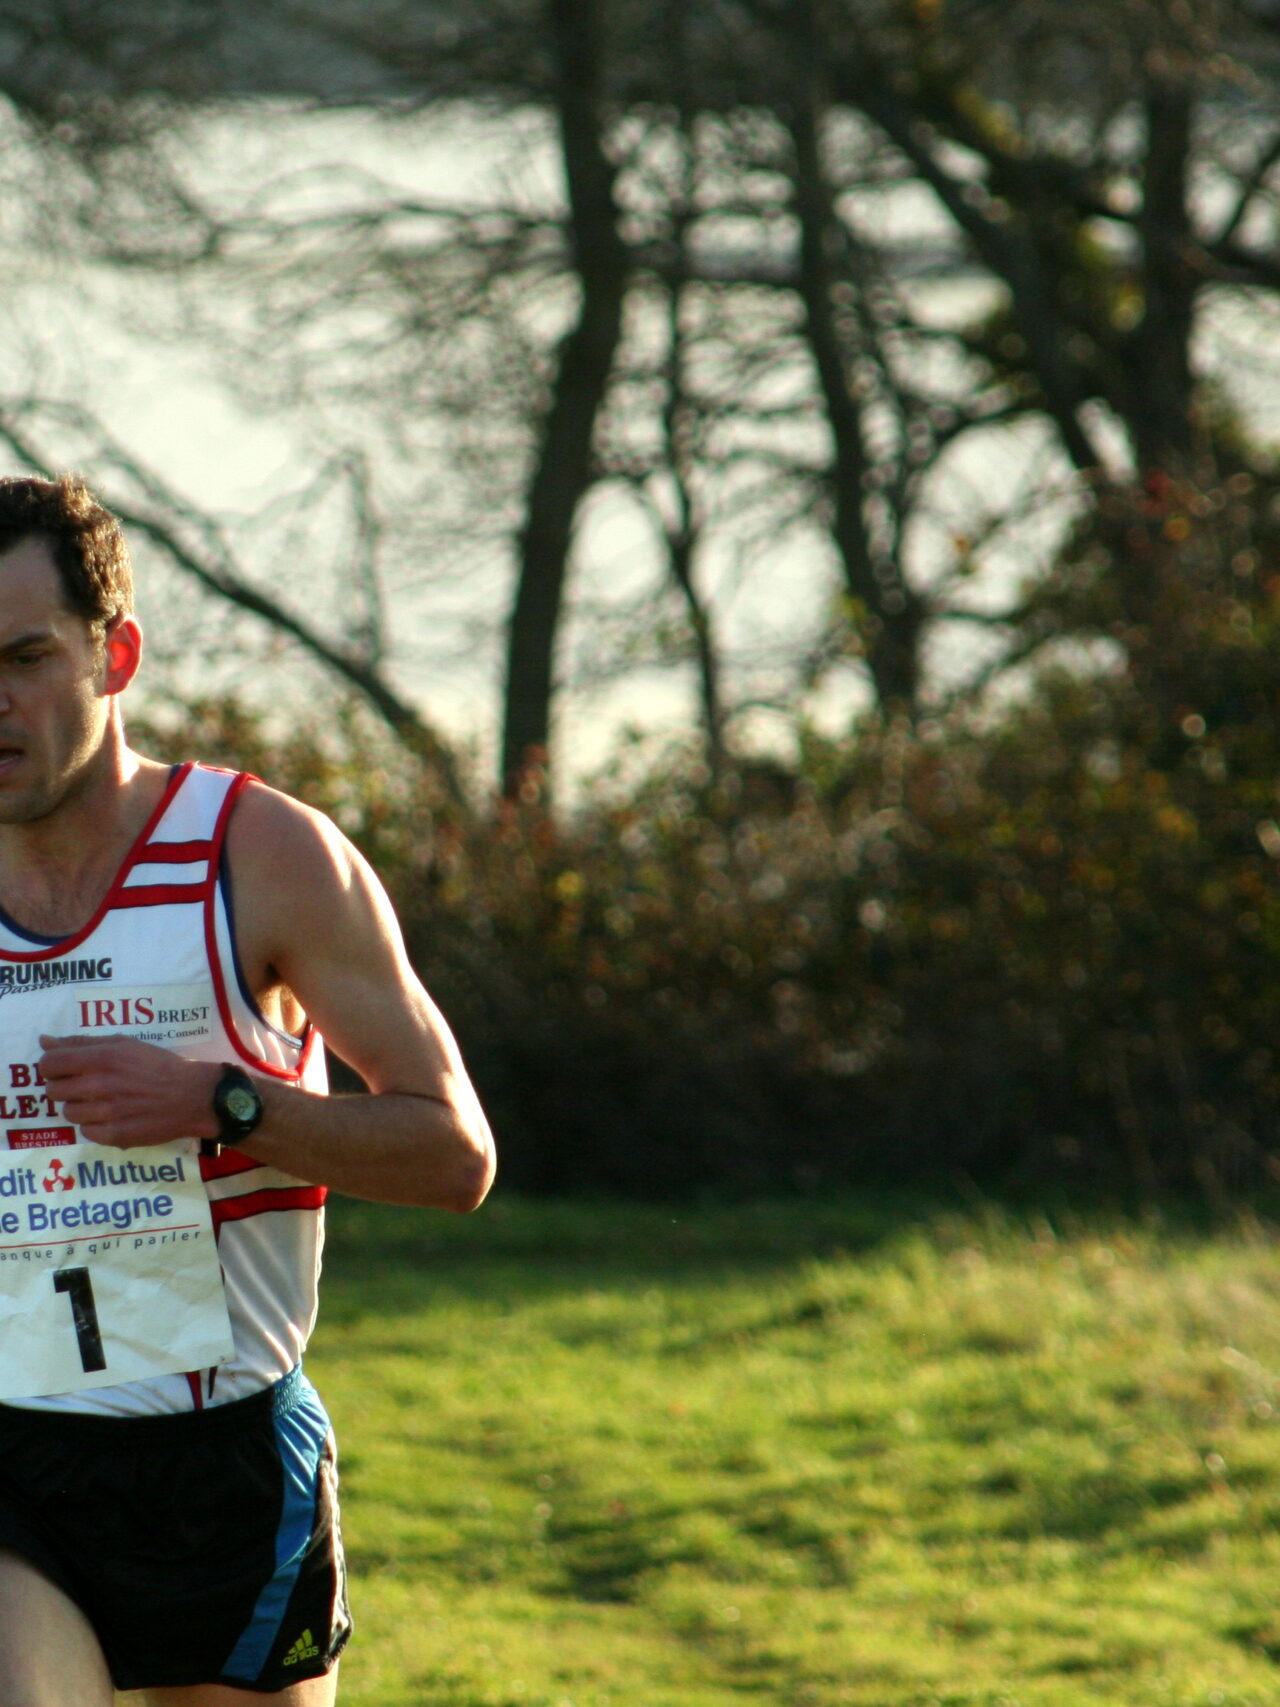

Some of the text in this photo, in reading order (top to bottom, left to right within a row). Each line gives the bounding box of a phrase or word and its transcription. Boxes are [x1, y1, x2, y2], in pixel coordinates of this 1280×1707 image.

[0, 958, 112, 986] RUNNING
[77, 997, 209, 1028] IRIS BREST
[22, 1131, 58, 1141] STADE
[77, 1157, 186, 1189] Mutuel
[28, 1194, 173, 1231] Bretagne
[66, 1244, 75, 1256] à
[89, 1236, 120, 1255] qui
[134, 1230, 201, 1249] parler
[53, 1267, 107, 1373] 1
